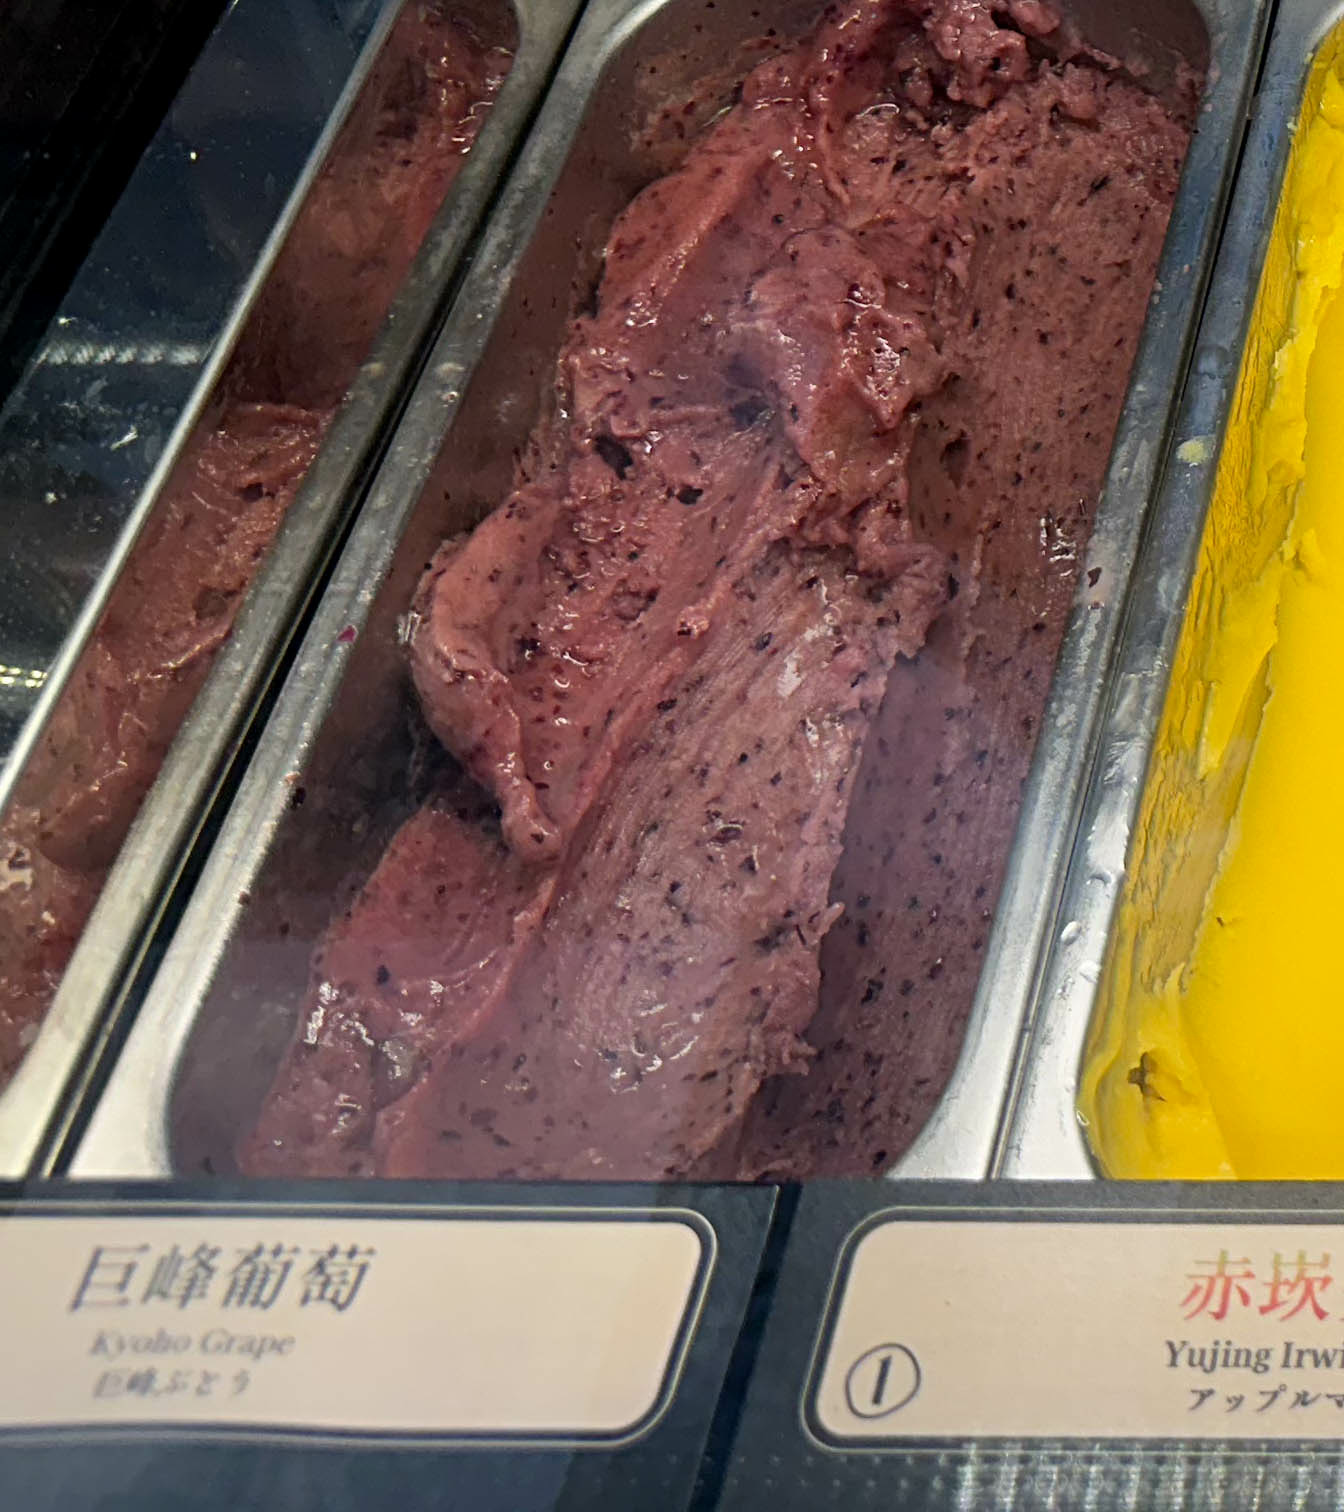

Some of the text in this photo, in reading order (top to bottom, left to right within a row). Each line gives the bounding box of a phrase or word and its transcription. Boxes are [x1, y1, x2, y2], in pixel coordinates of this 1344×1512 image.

[69, 1243, 376, 1313] 巨峰葡萄
[90, 1329, 295, 1361] Kyoho Grape
[1165, 1340, 1272, 1375] Yujing
